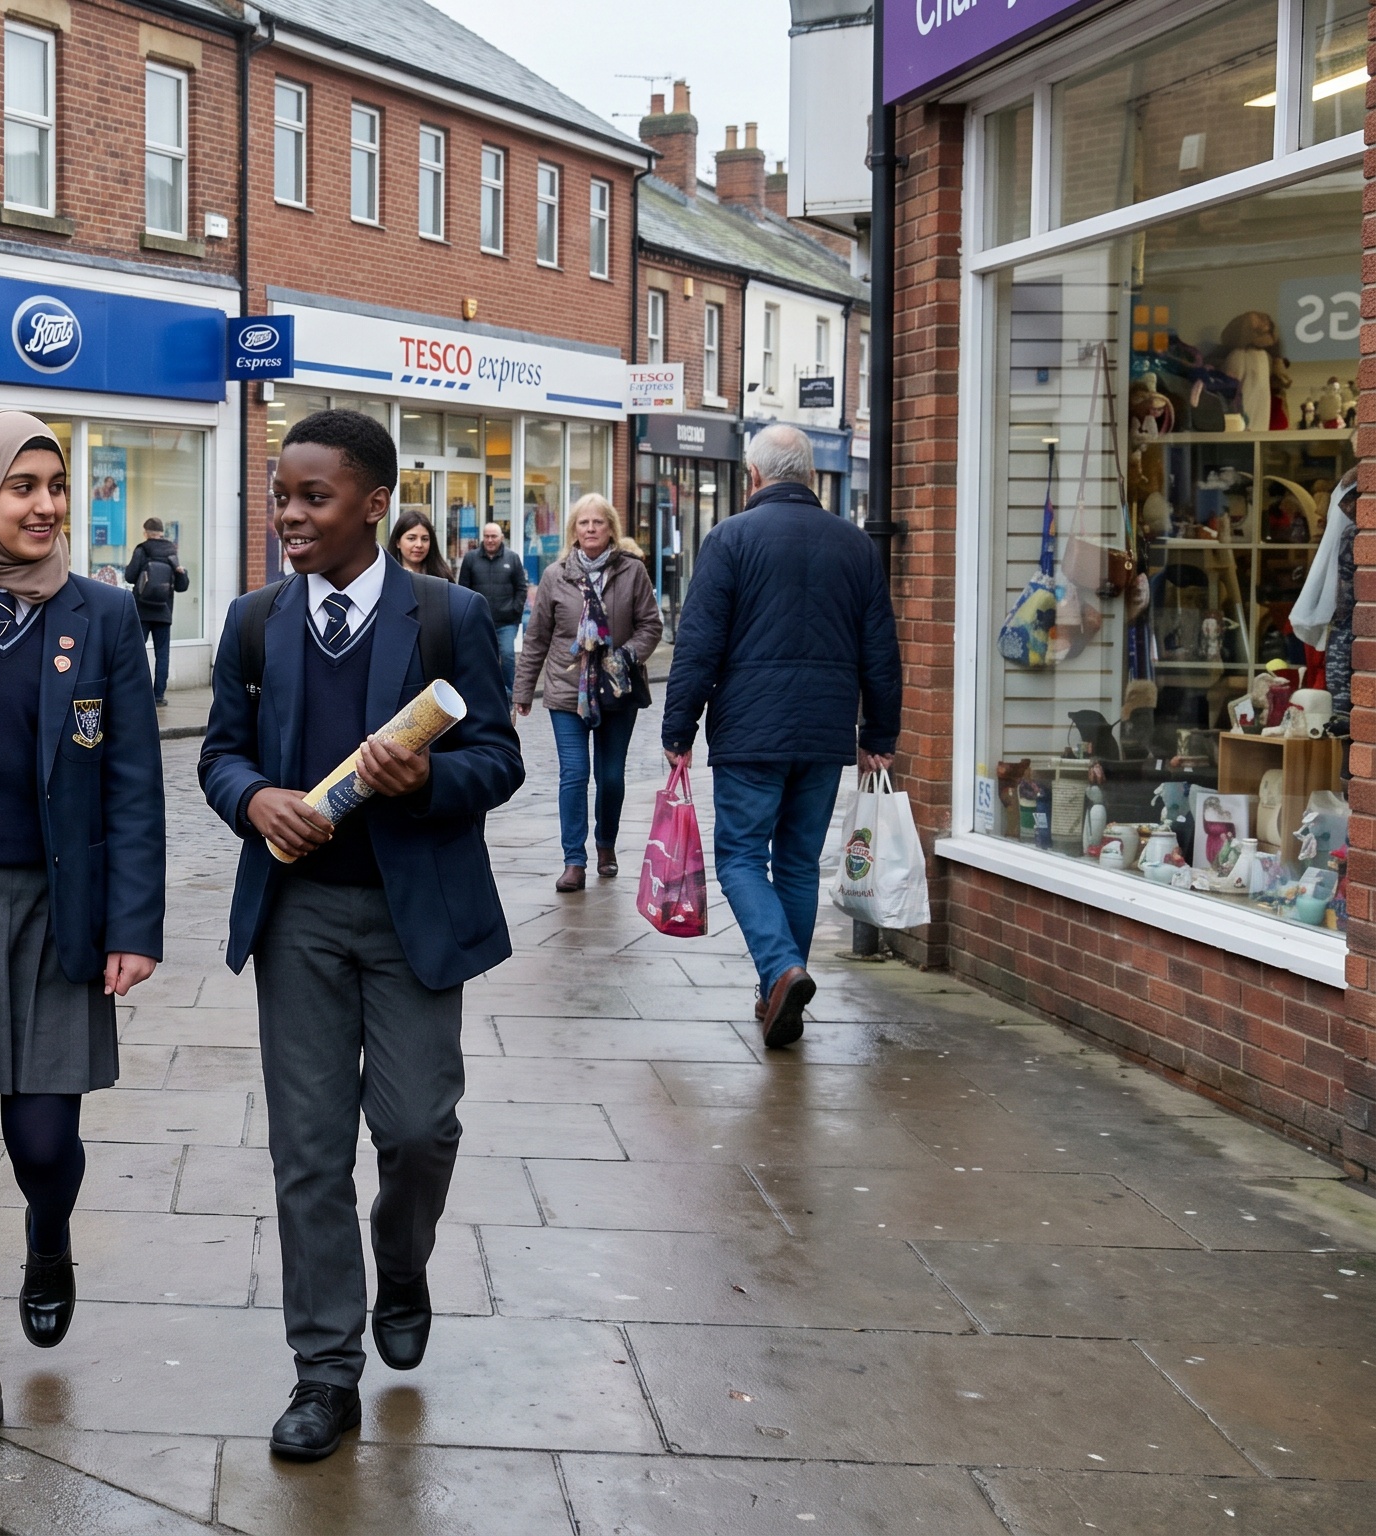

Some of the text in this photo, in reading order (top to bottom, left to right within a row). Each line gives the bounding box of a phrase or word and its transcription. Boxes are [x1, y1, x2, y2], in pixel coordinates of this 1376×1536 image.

[24, 312, 74, 355] Boots
[399, 336, 543, 393] TESCO express
[629, 372, 674, 382] TESCO
